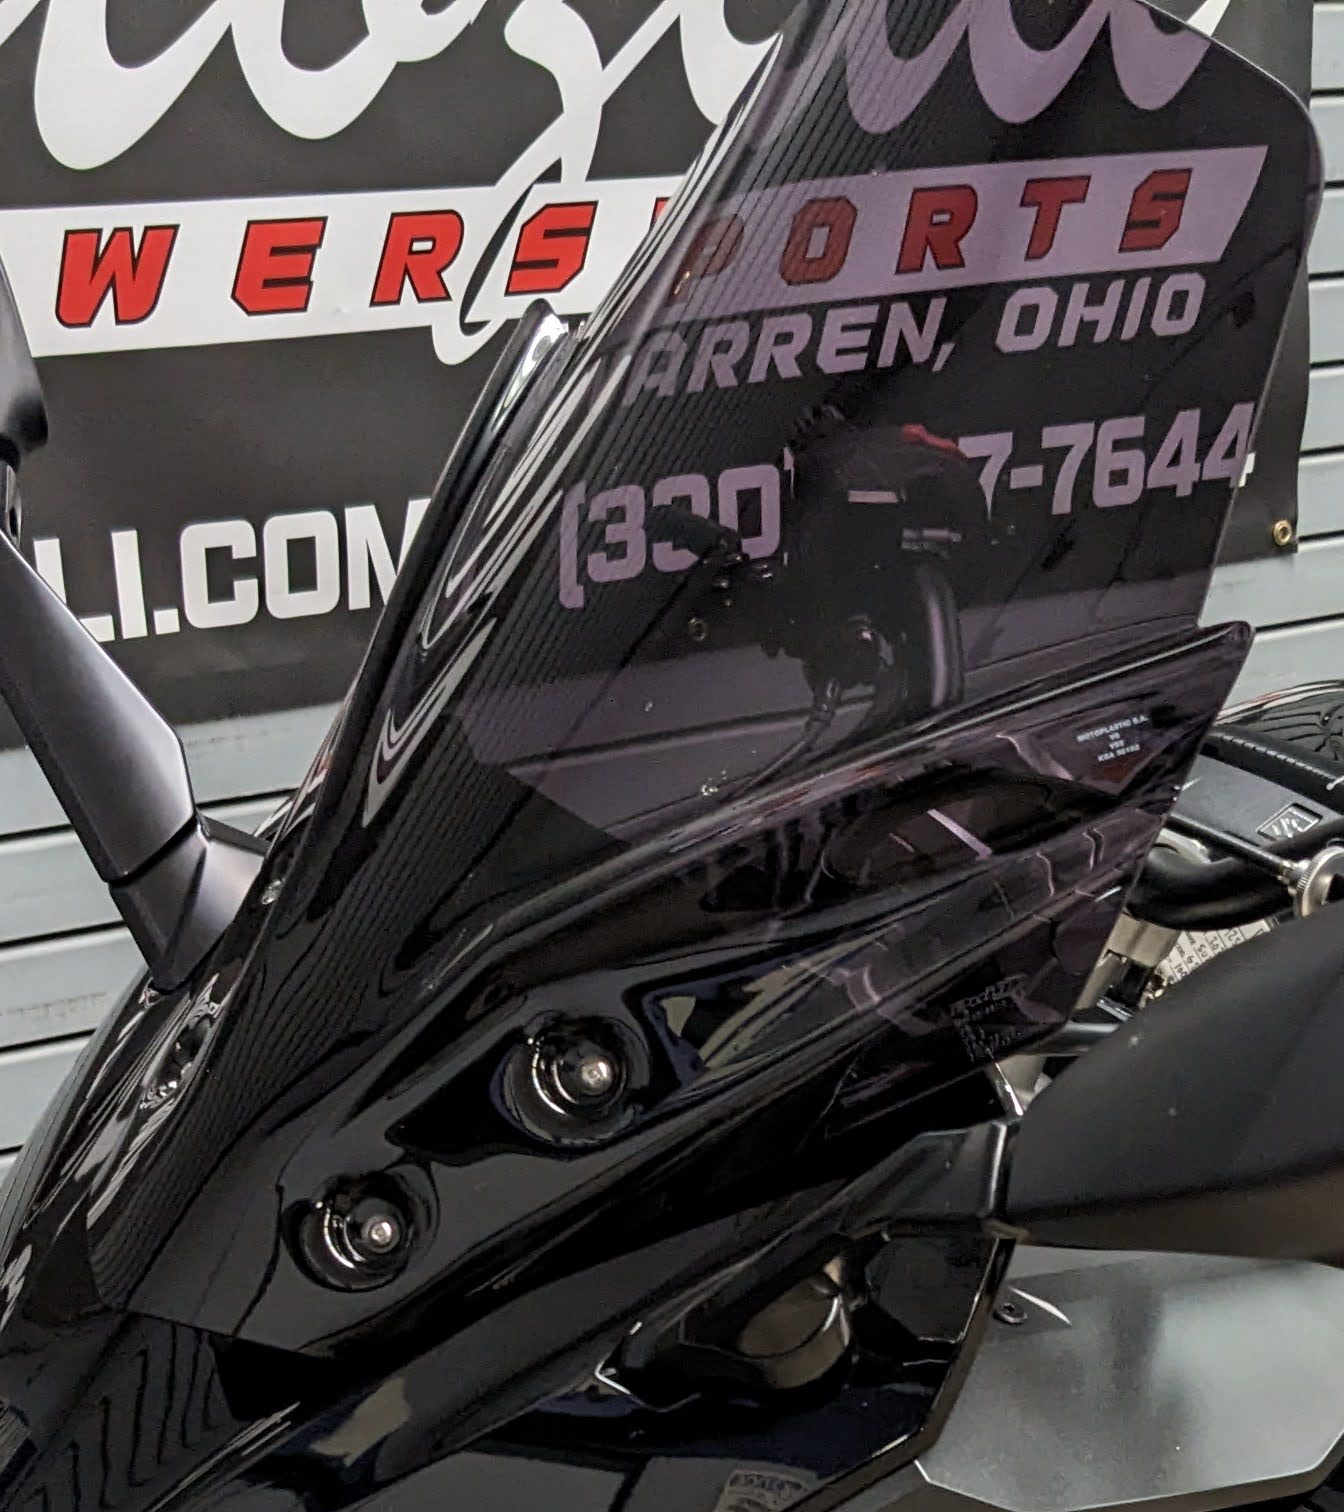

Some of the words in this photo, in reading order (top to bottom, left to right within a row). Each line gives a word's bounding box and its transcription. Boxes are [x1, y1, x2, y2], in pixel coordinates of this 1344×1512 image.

[622, 296, 955, 407] ARREN,
[996, 272, 1207, 355] OHIO
[559, 446, 796, 609] (330
[956, 402, 1256, 522] 7-7644
